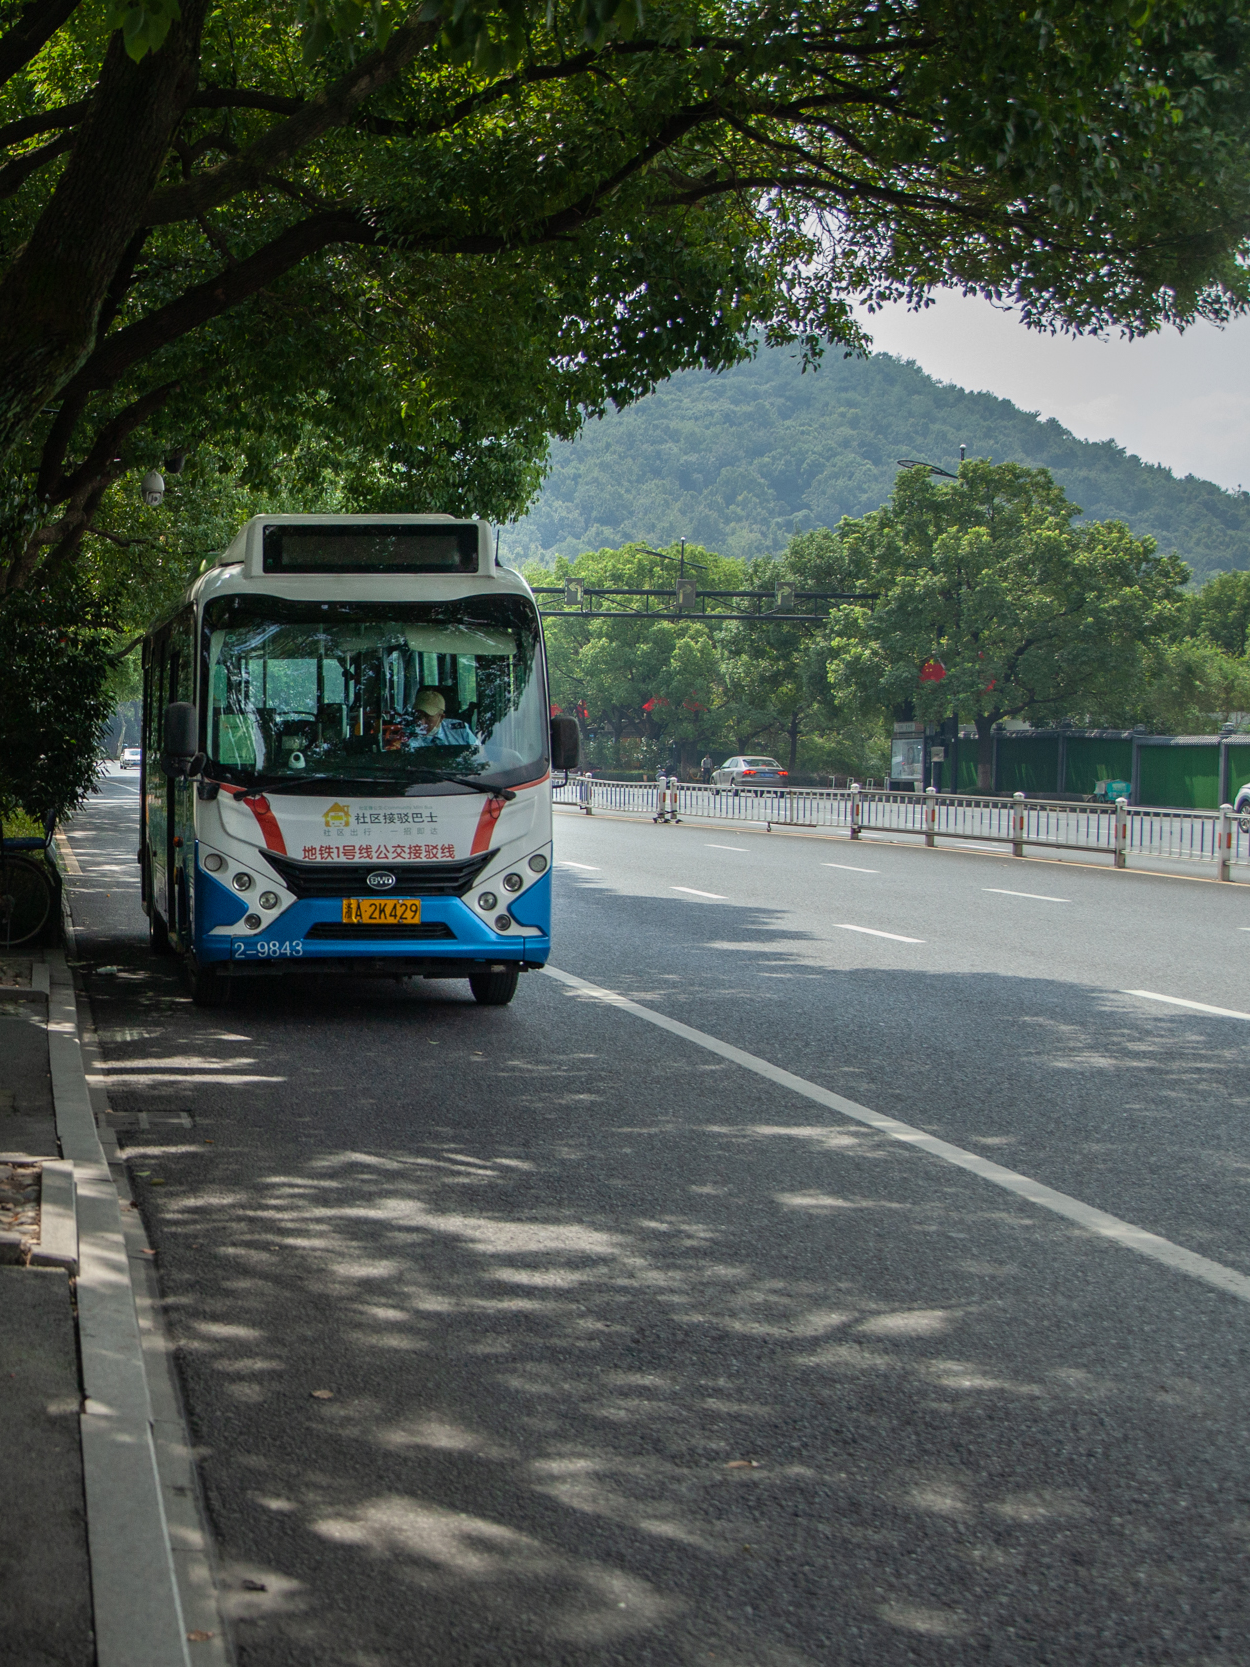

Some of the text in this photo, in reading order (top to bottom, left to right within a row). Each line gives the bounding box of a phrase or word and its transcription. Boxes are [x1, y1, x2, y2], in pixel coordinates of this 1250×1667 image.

[354, 811, 438, 825] 社区接驳巴士
[302, 843, 456, 861] 地铁1号线公交接驳线
[369, 876, 393, 885] BYD
[234, 940, 303, 959] 2-9843
